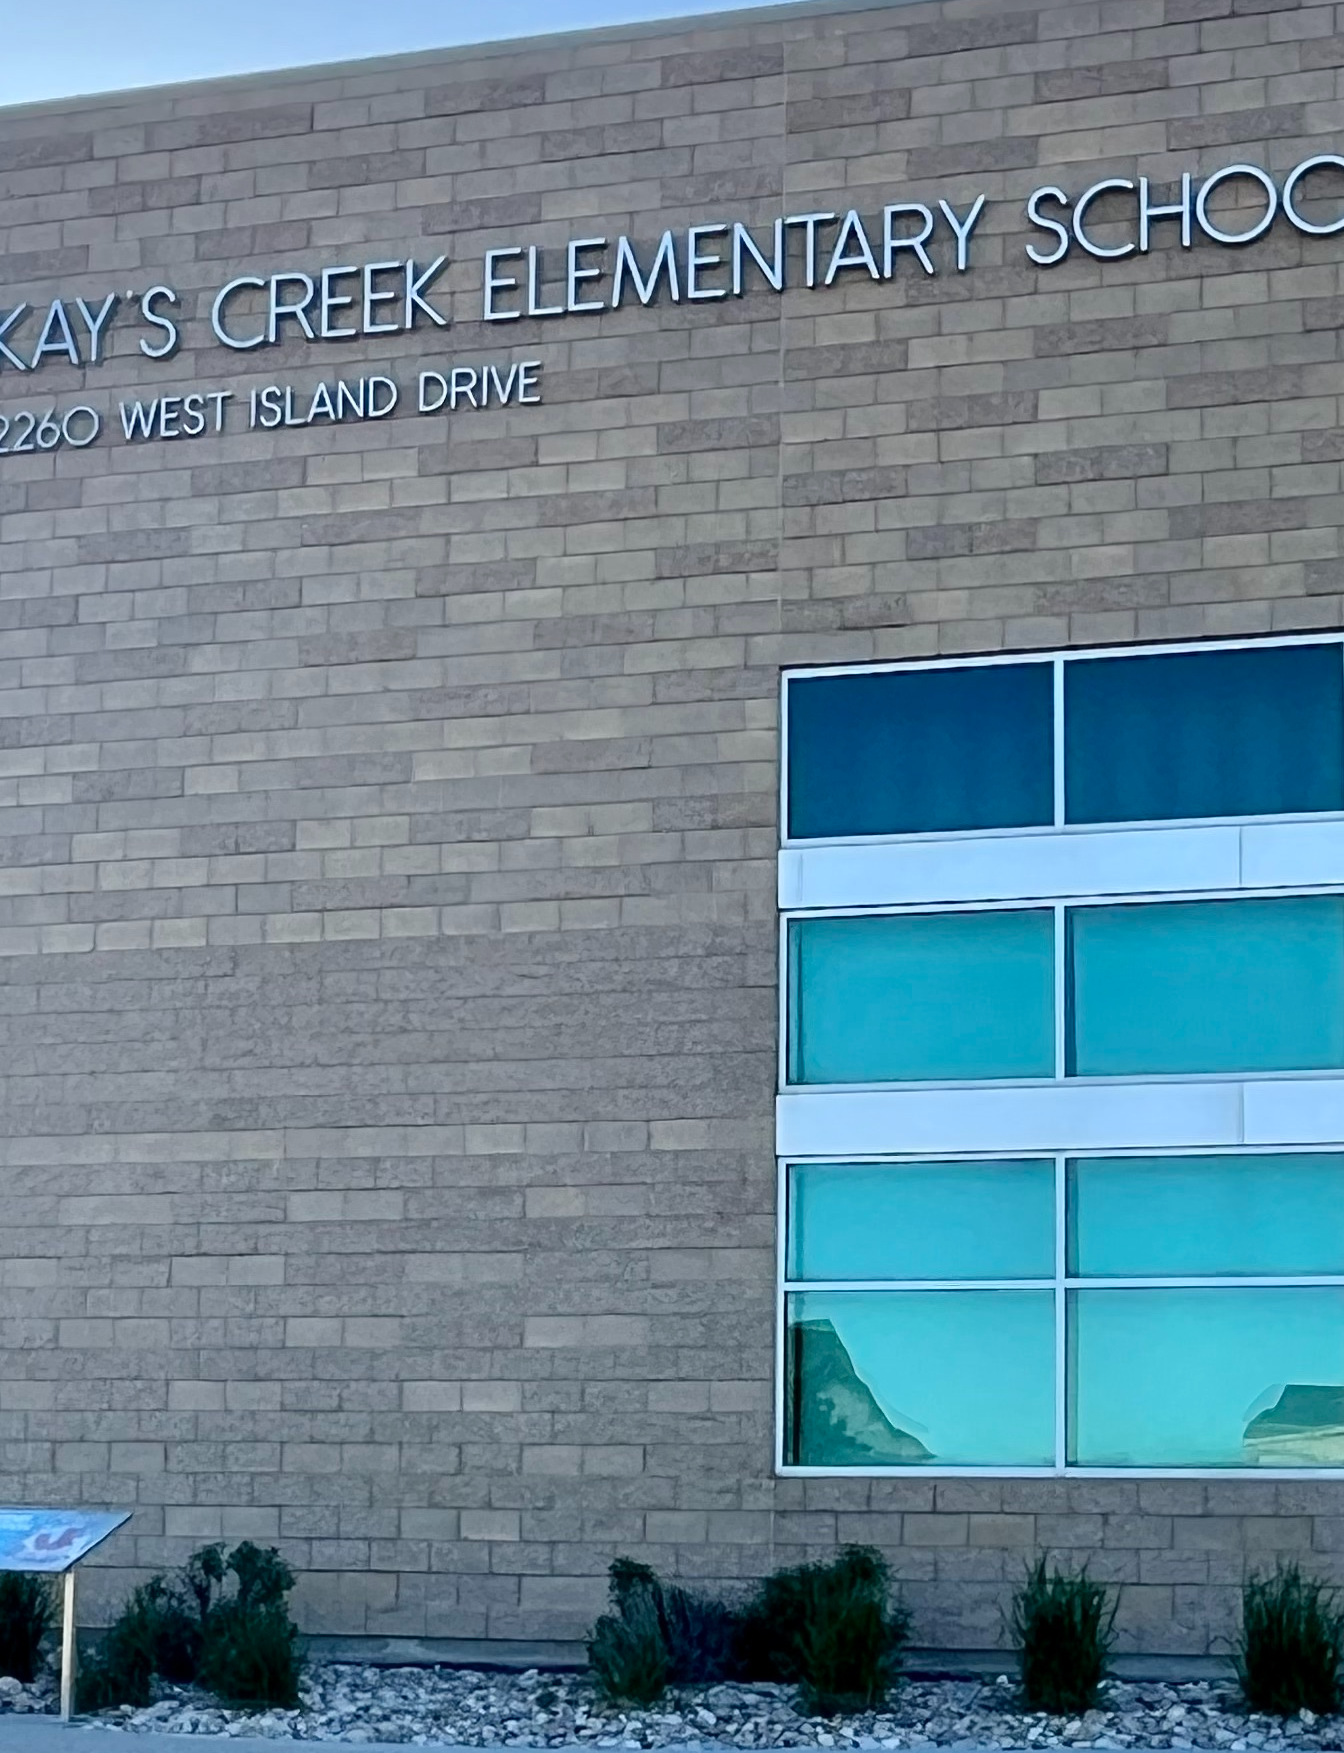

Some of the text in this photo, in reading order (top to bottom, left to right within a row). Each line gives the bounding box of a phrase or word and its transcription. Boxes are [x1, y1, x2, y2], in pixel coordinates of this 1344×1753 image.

[211, 255, 448, 350] CREEK
[483, 194, 986, 321] ELEMENTARY
[118, 391, 232, 440] WEST
[250, 376, 398, 429] ISLAND
[418, 361, 543, 412] DRIVE
